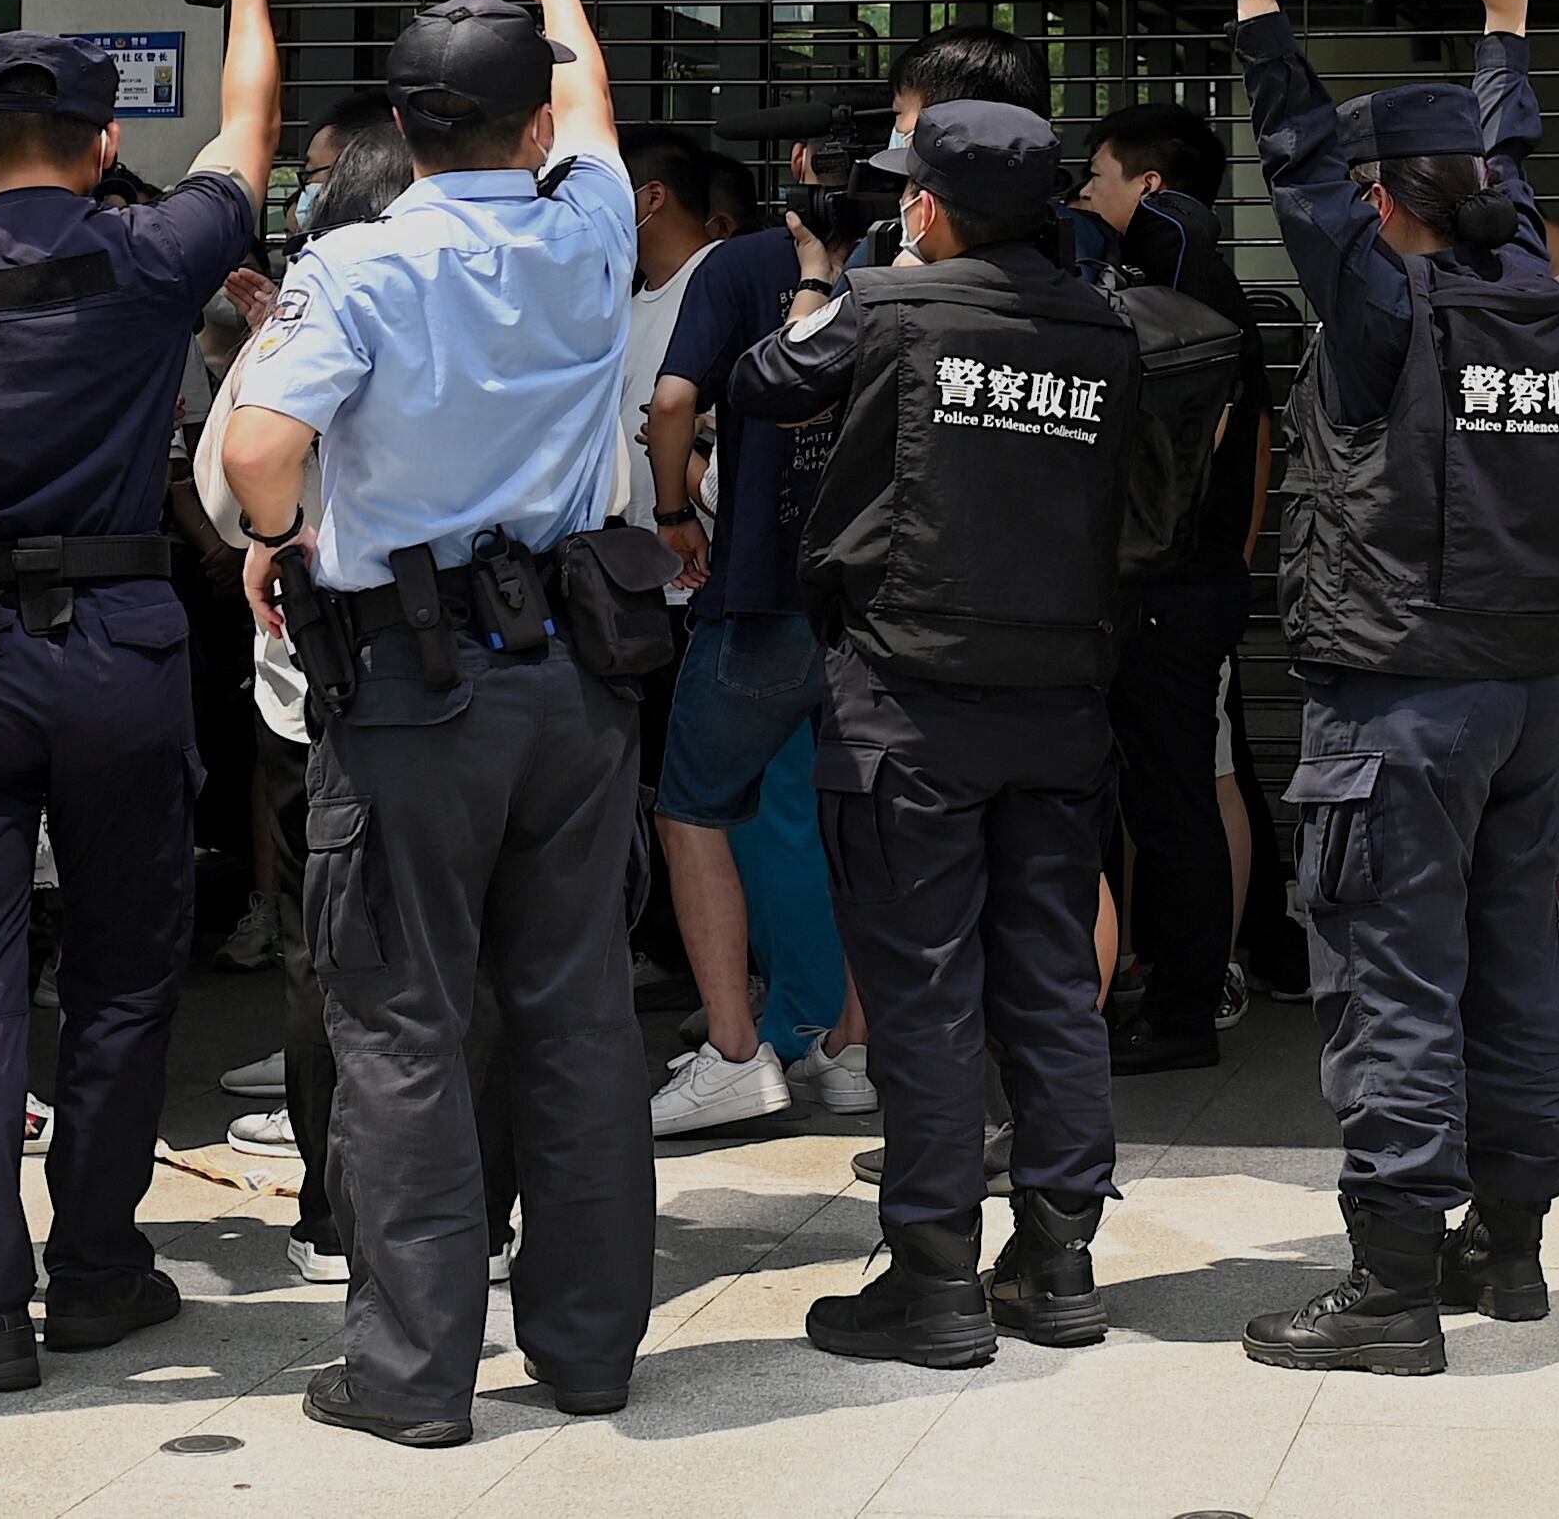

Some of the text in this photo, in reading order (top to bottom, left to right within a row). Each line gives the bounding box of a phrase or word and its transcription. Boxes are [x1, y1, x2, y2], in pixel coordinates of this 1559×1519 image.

[935, 356, 1108, 422] 警察取证
[932, 408, 1098, 445] Police Evidence Collecting
[1455, 417, 1503, 433] Police
[1504, 419, 1559, 434] Evidence
